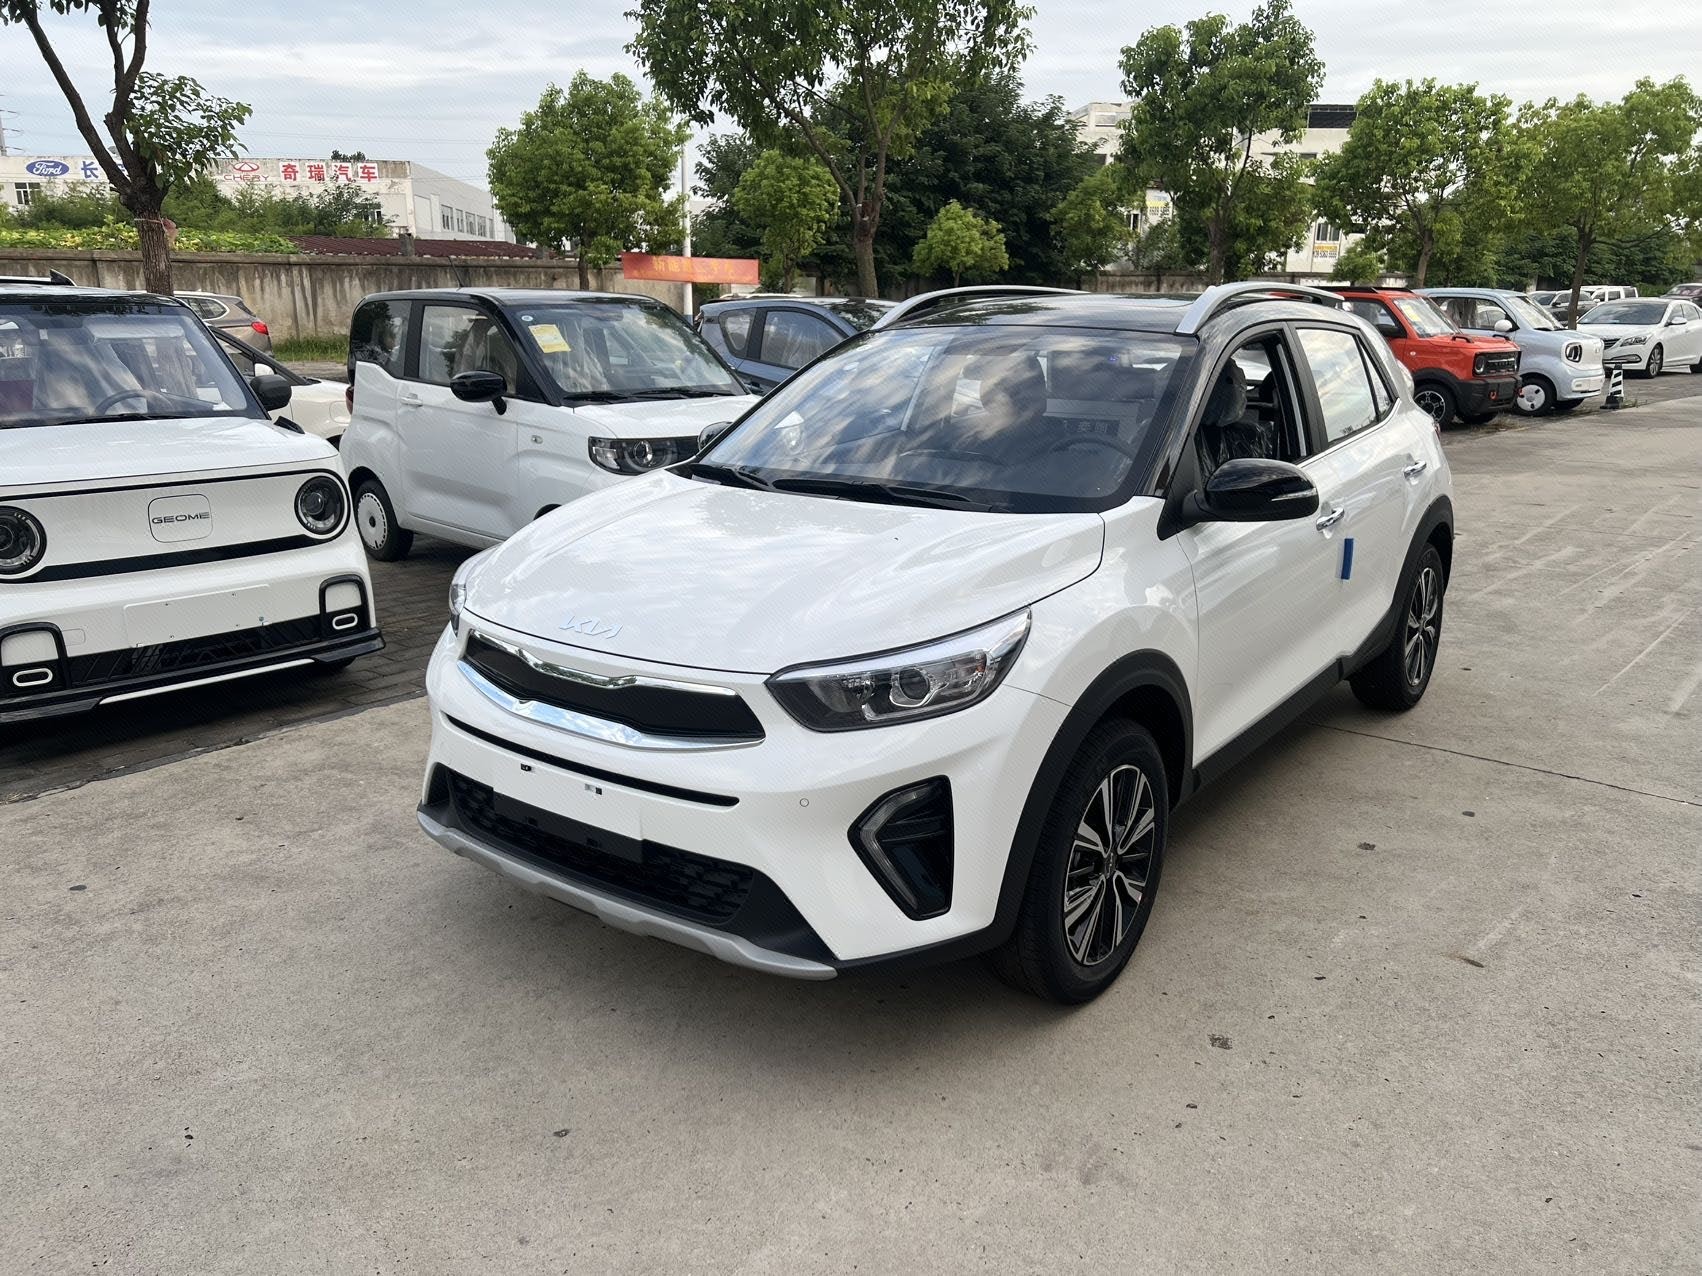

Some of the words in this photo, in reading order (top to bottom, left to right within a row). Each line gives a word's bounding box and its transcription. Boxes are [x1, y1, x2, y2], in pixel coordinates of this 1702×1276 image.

[32, 161, 63, 175] Ford
[281, 163, 378, 183] 奇瑞汽车
[151, 512, 210, 524] GEOME
